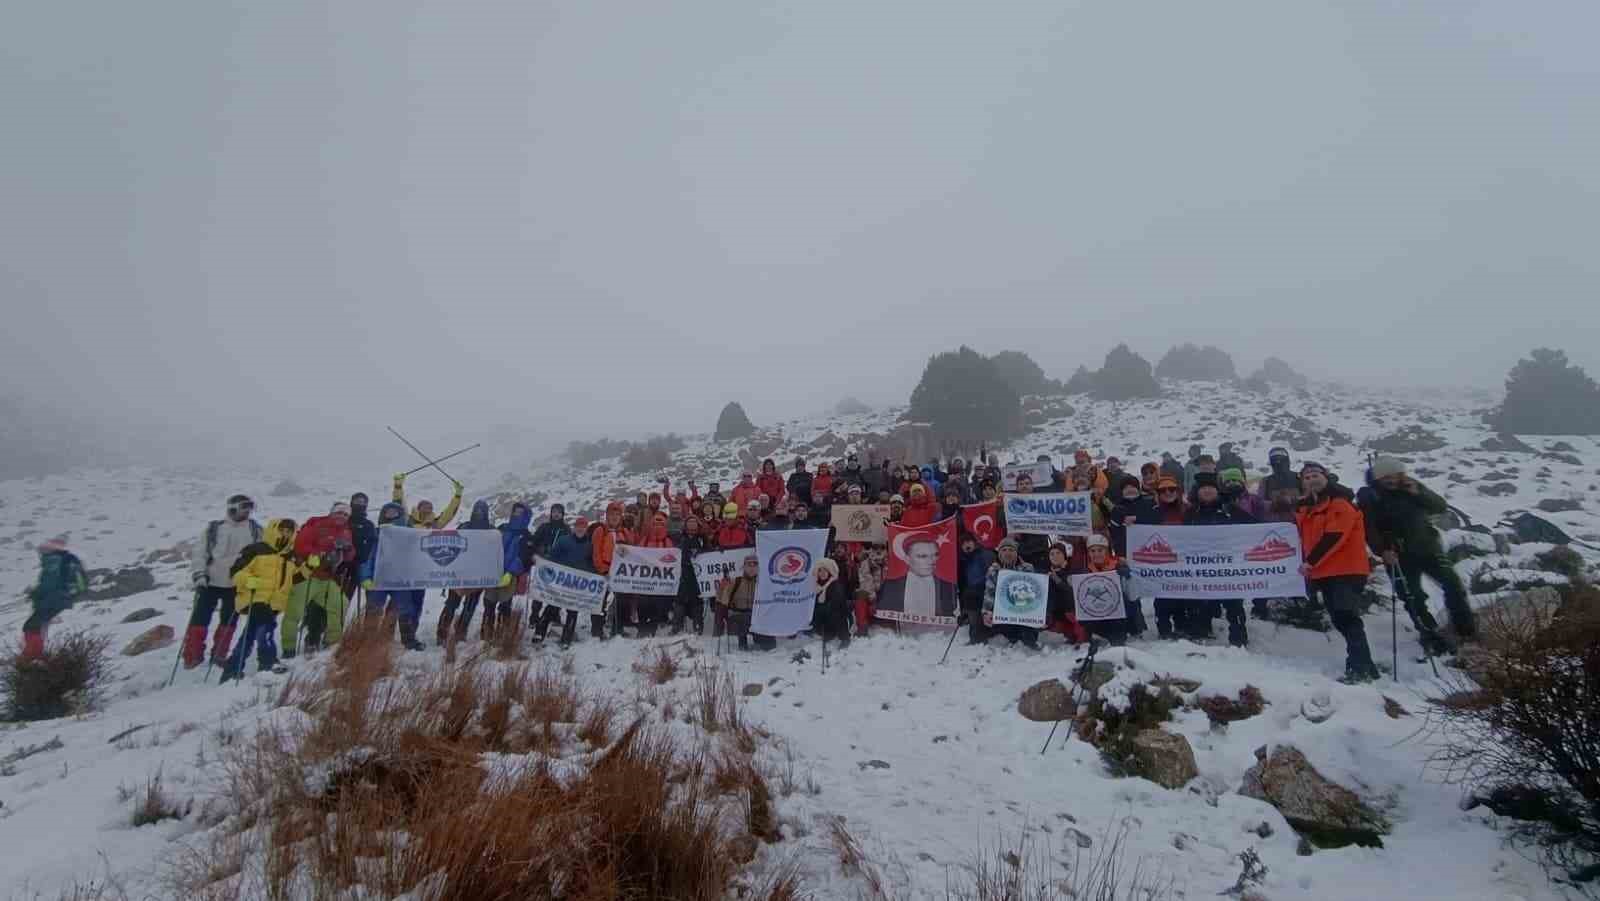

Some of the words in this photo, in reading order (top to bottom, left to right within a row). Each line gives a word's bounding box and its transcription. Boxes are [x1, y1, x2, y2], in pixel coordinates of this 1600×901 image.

[1028, 497, 1086, 514] PAKDOS
[1184, 553, 1233, 565] TÜRKİYE
[616, 562, 675, 580] AYDAK
[1196, 565, 1286, 578] FEDERASYONU
[555, 571, 605, 594] PAKDOS
